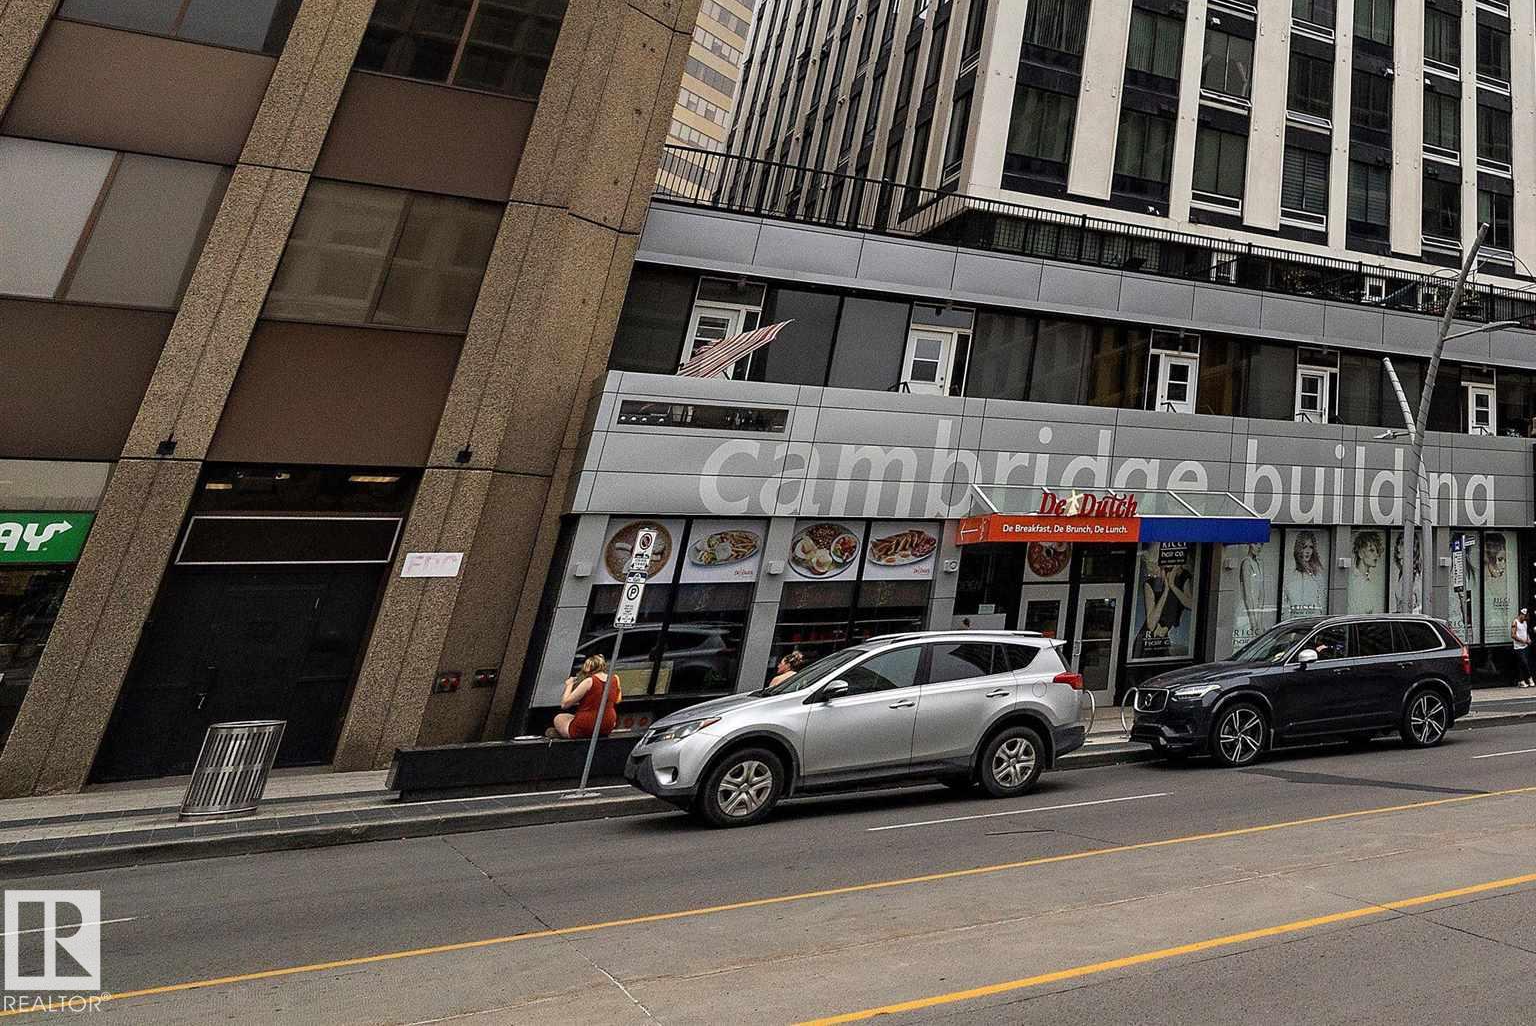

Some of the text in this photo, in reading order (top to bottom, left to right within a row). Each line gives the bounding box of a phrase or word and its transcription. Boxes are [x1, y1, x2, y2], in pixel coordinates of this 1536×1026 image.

[699, 419, 1208, 517] cambridge
[1244, 439, 1495, 526] buildng
[1003, 525, 1128, 534] De Breakfast, De Brunch, De Lunch.
[1039, 493, 1138, 517] De Dutch
